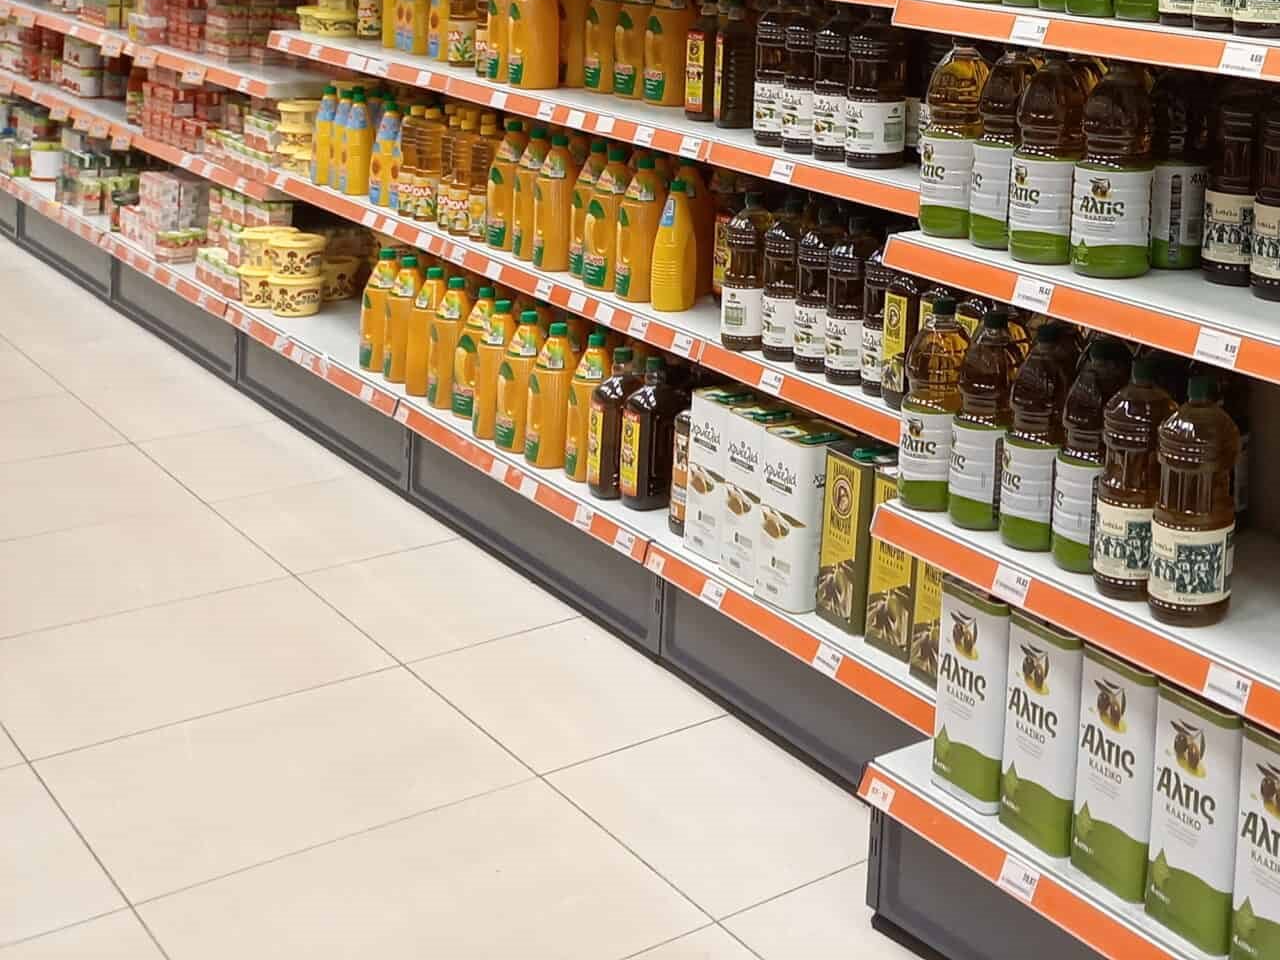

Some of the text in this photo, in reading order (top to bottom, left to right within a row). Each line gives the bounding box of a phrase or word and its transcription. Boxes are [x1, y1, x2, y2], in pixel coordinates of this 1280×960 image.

[1079, 195, 1125, 217] Άλτις
[939, 651, 987, 702] Άλτις
[1009, 685, 1058, 739] Άλτις
[1080, 721, 1136, 779] Άλτις
[1156, 766, 1216, 825] Άλτις
